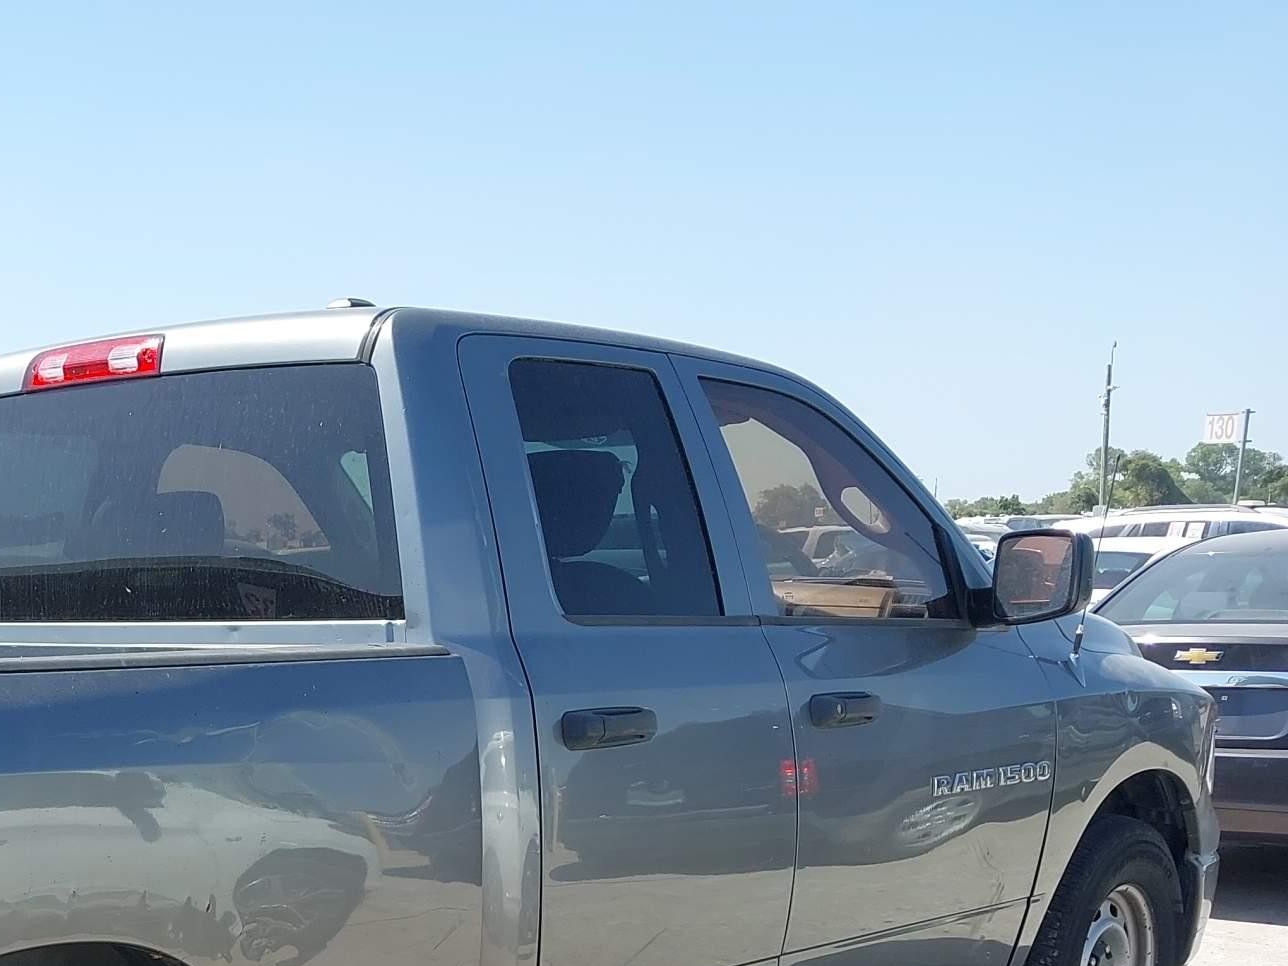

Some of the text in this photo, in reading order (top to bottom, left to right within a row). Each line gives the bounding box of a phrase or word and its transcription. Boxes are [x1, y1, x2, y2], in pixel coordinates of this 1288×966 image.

[1208, 415, 1234, 440] 130
[931, 760, 1051, 797] RAM 1500
